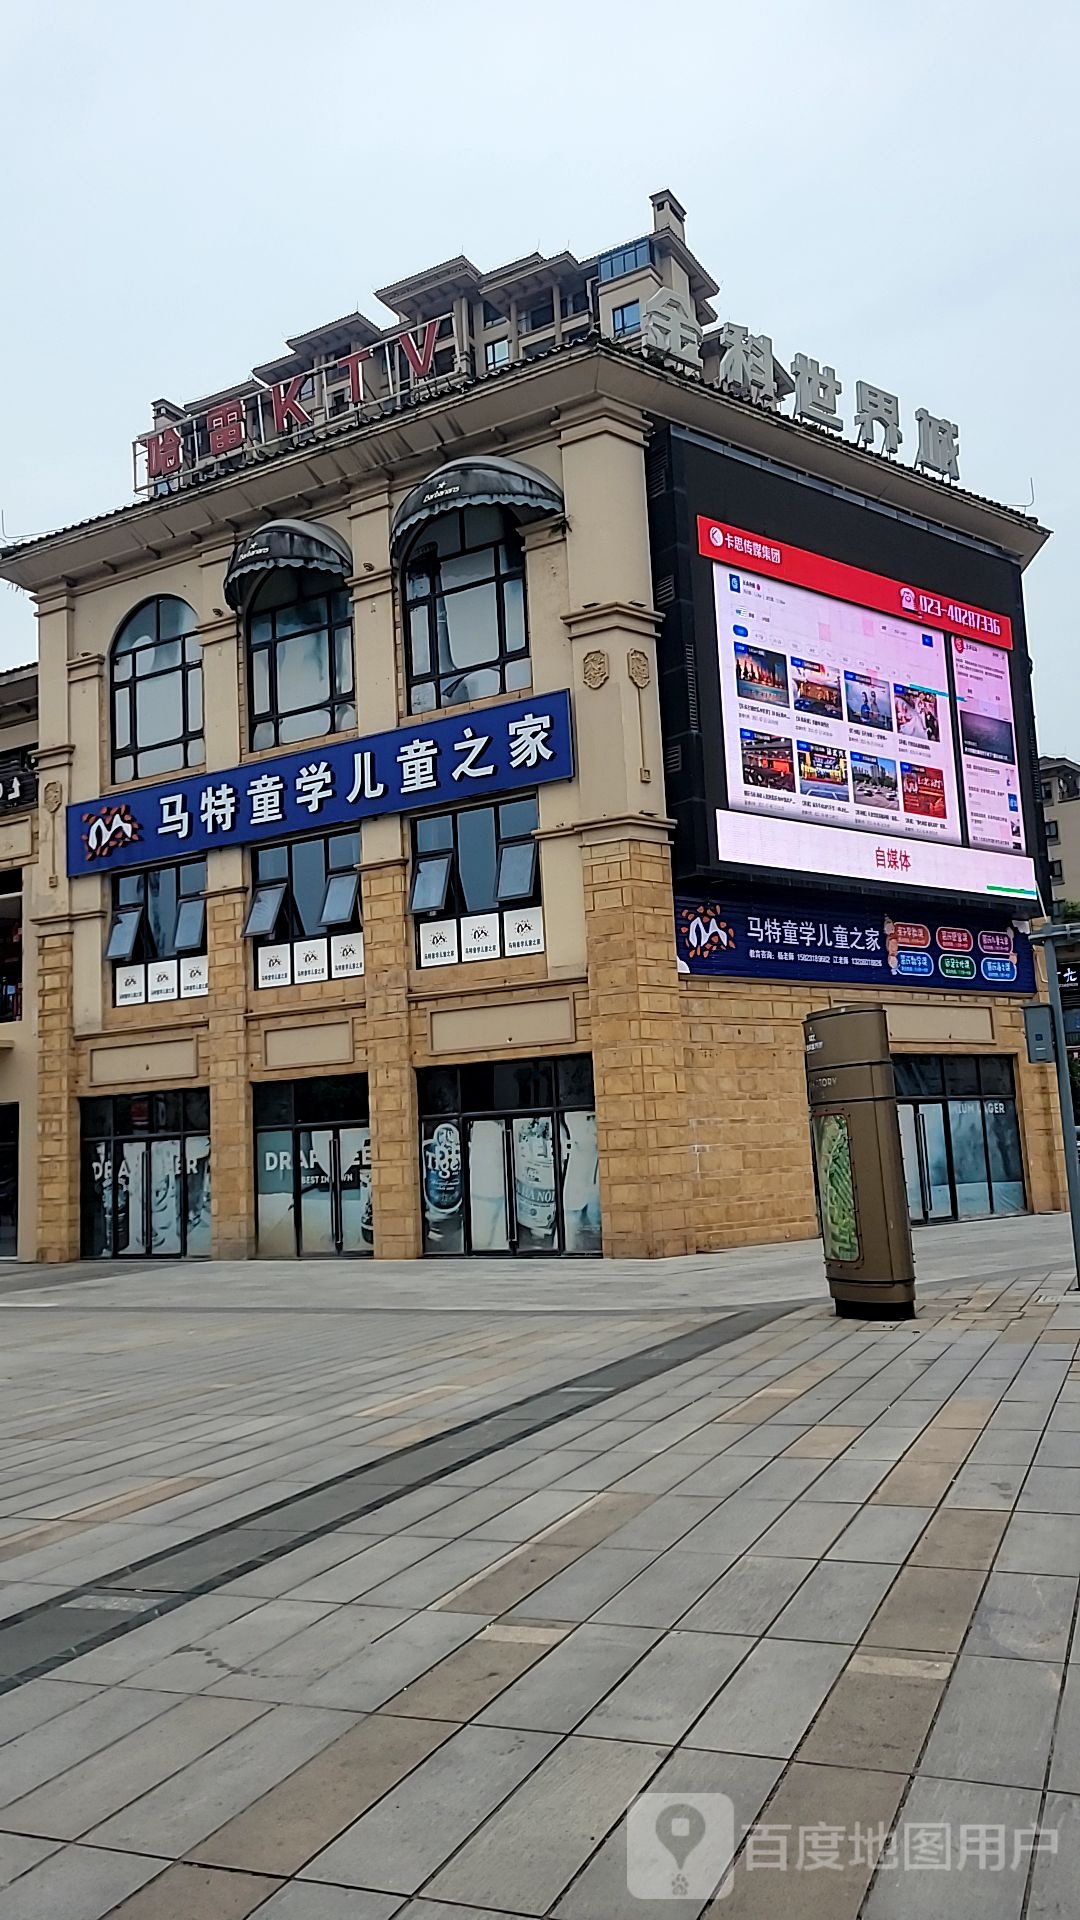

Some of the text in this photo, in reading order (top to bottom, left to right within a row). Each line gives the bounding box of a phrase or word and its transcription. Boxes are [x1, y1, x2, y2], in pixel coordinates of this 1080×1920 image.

[642, 287, 960, 481] 金科世界城
[725, 533, 781, 564] 卡思传媒集团
[157, 713, 554, 839] 马特童学儿童之家
[875, 847, 912, 872] 自媒体
[747, 916, 881, 951] 马特童学儿童之家
[302, 1176, 319, 1184] BEST
